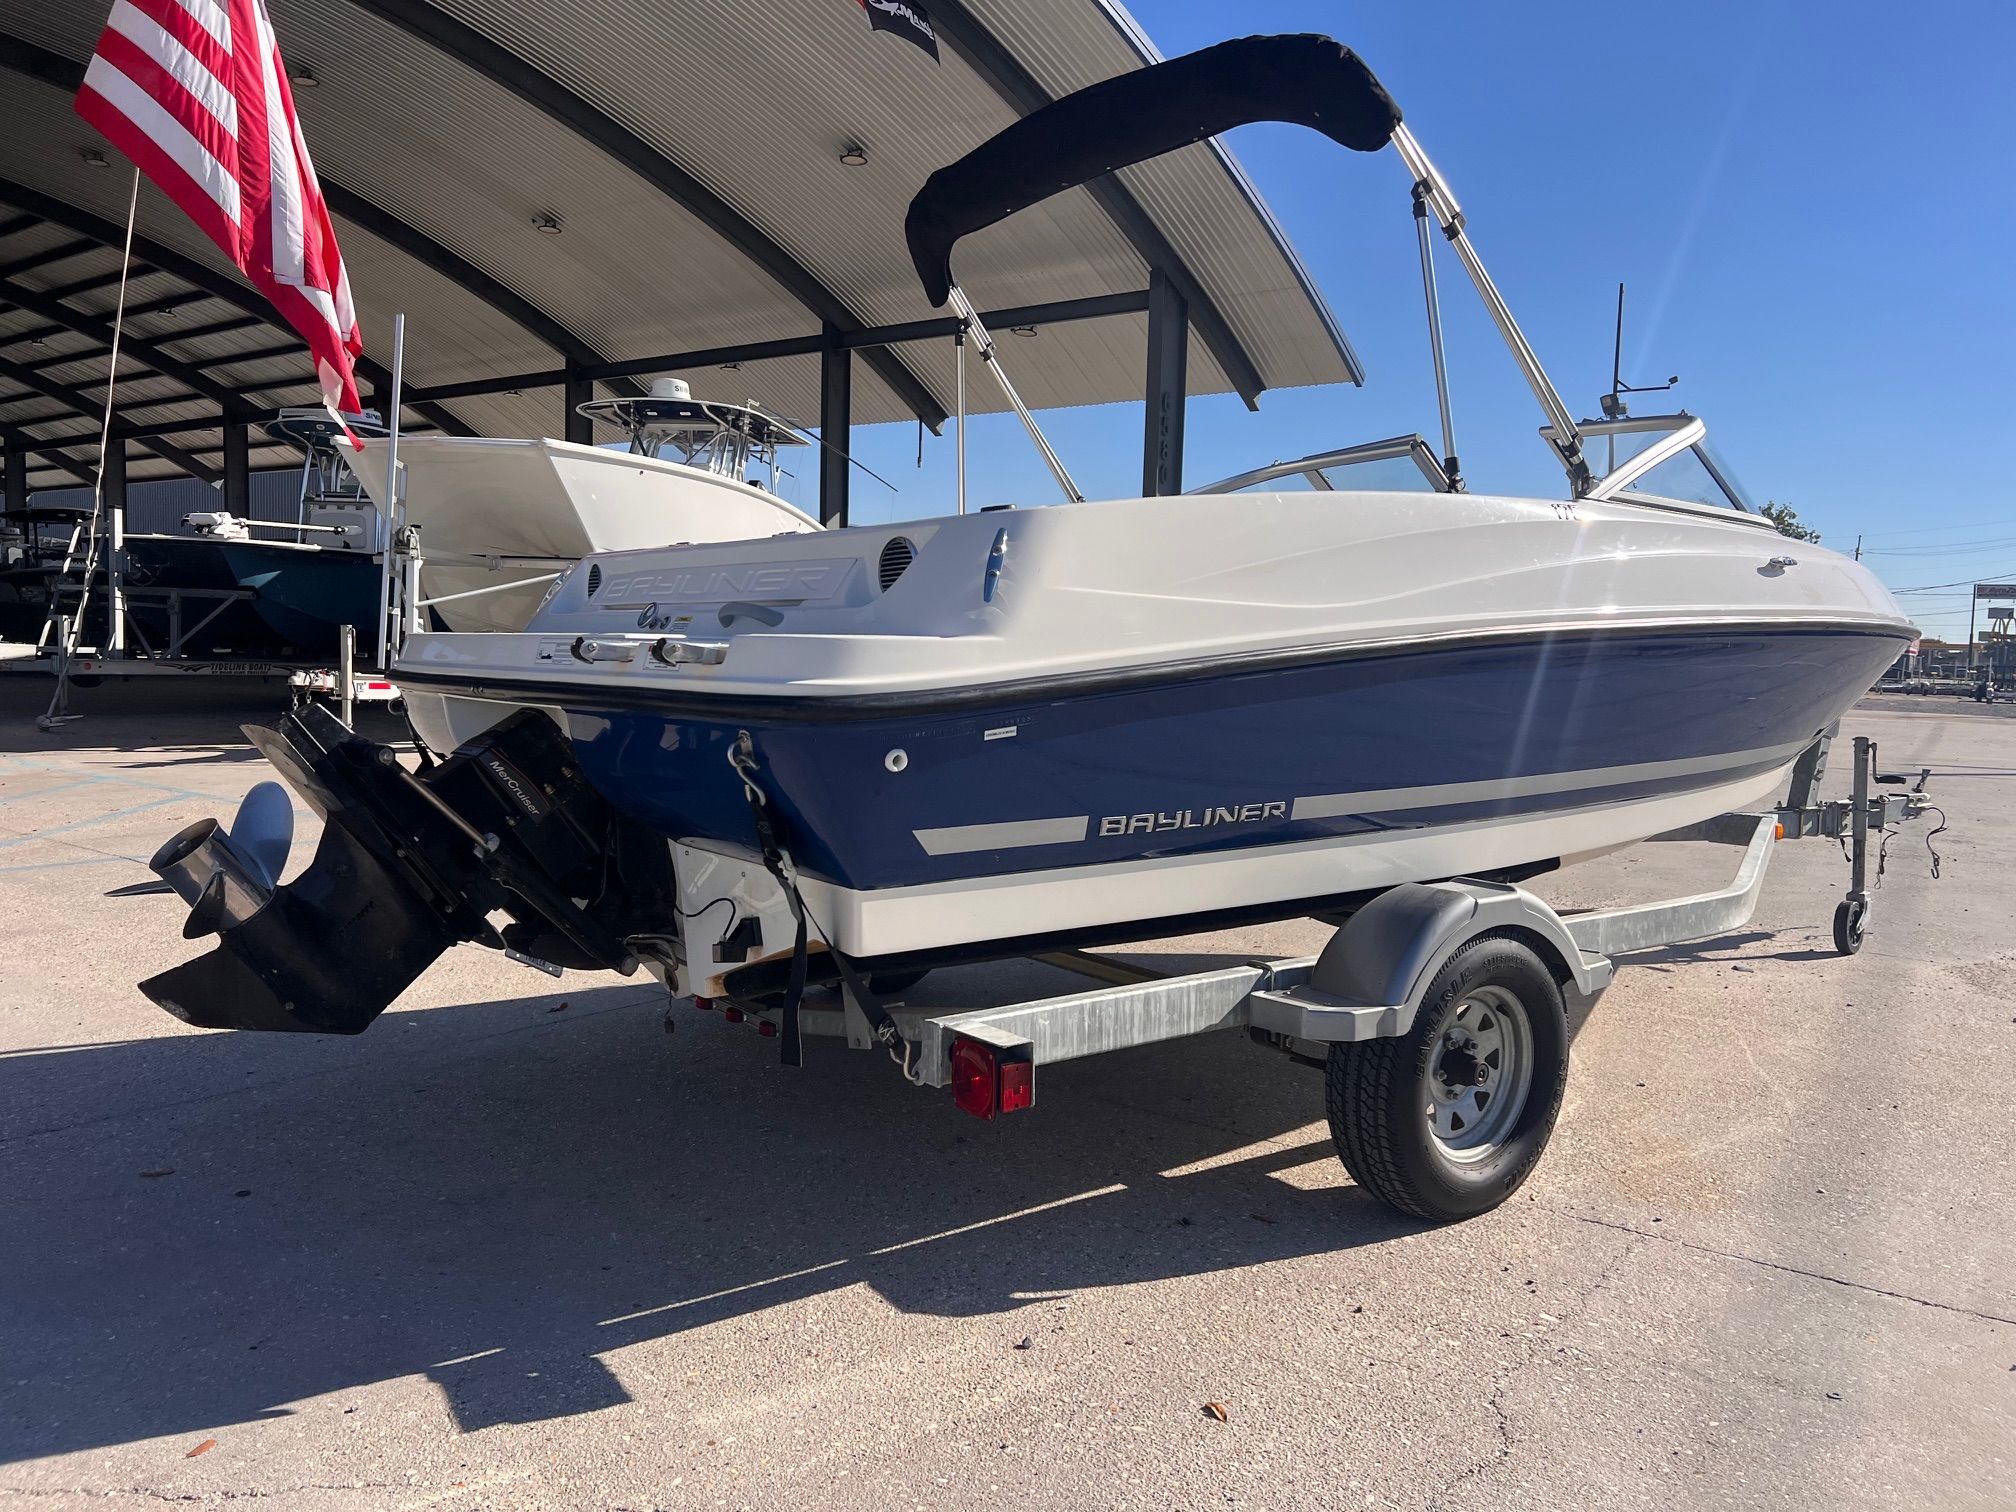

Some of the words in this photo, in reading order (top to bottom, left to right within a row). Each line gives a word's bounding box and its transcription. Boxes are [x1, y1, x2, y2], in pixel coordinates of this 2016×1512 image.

[603, 567, 831, 601] BAYLINER
[210, 663, 247, 671] TIDELINE
[249, 663, 272, 671] BOATS
[489, 761, 540, 814] MerCruiser
[1098, 801, 1286, 837] BAYLINER
[1415, 966, 1474, 1081] CARLISLE
